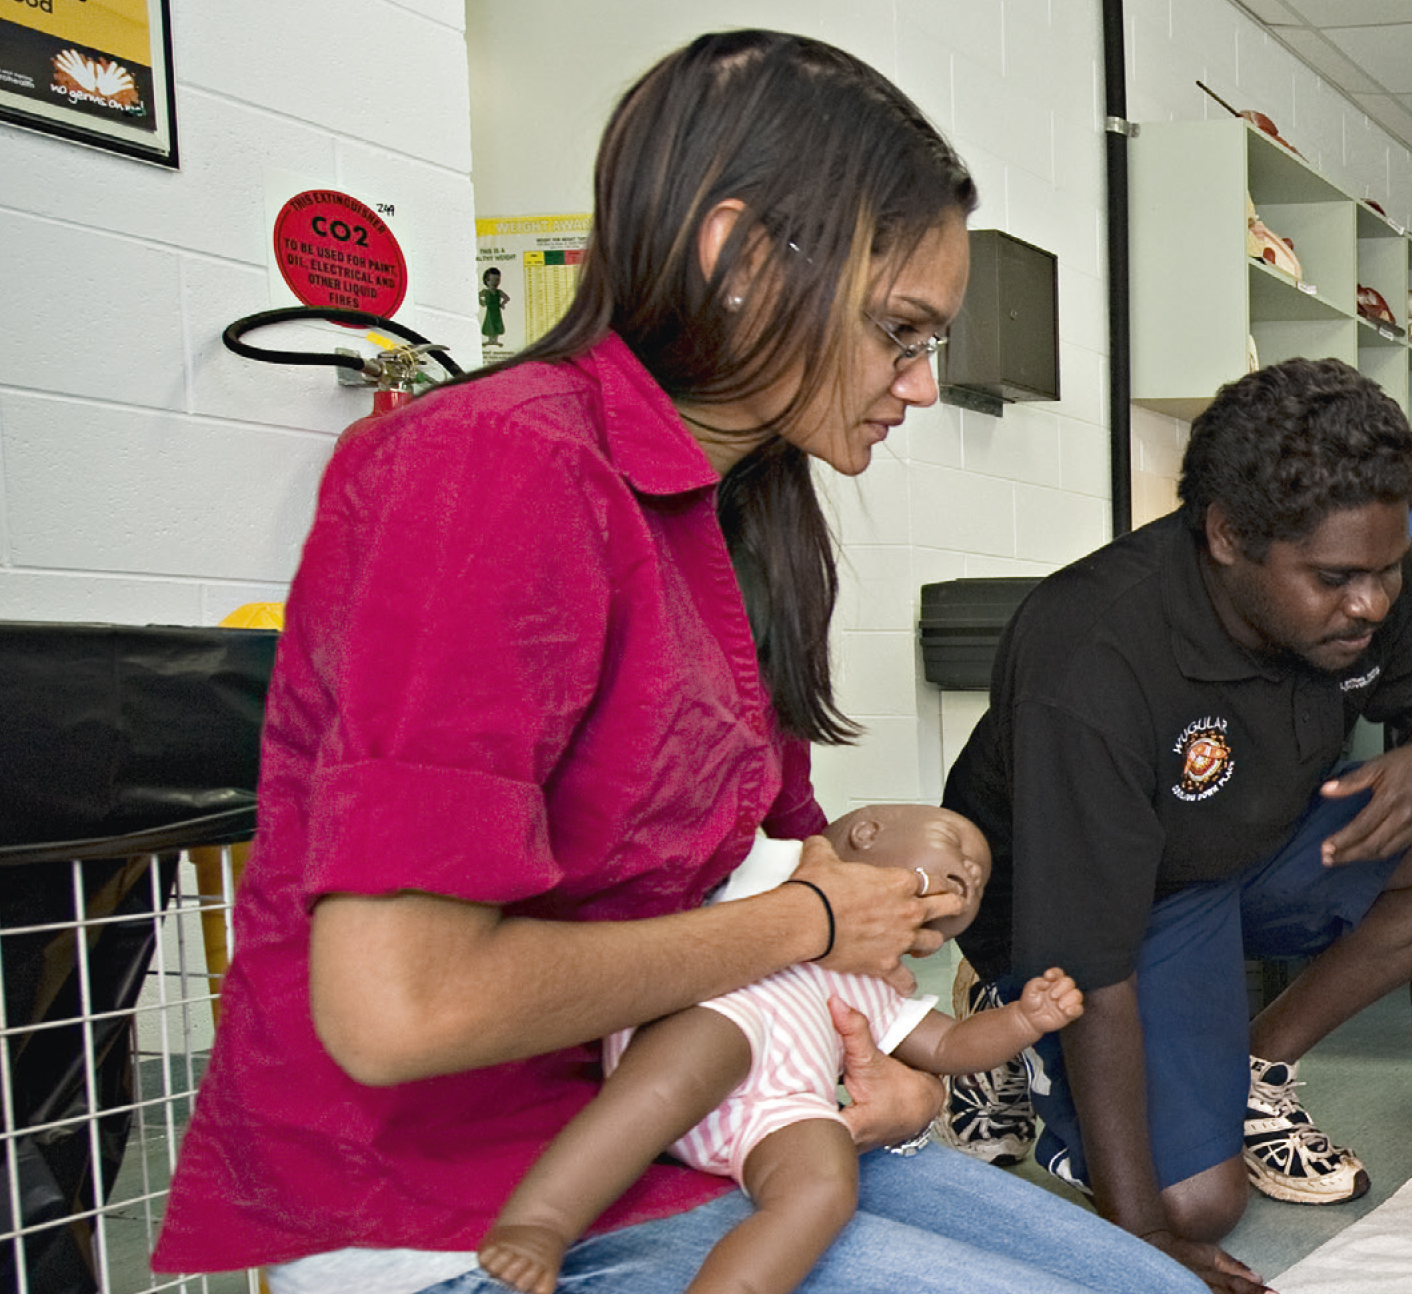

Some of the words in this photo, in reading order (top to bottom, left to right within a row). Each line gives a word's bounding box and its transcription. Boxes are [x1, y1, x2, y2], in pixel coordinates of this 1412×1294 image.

[50, 83, 67, 94] no
[290, 193, 314, 212] THIS
[313, 192, 386, 235] EXTINGUISHER
[311, 216, 369, 248] CO2
[495, 221, 550, 234] WEIGHT
[284, 237, 298, 251] TO
[301, 242, 314, 255] BE
[317, 246, 344, 262] USED
[346, 253, 366, 267] FOR
[308, 273, 341, 290] OTHER
[343, 280, 378, 299] LIQUID
[311, 260, 373, 285] ELECTRICAL
[376, 276, 396, 289] AND
[329, 291, 360, 309] FIRES
